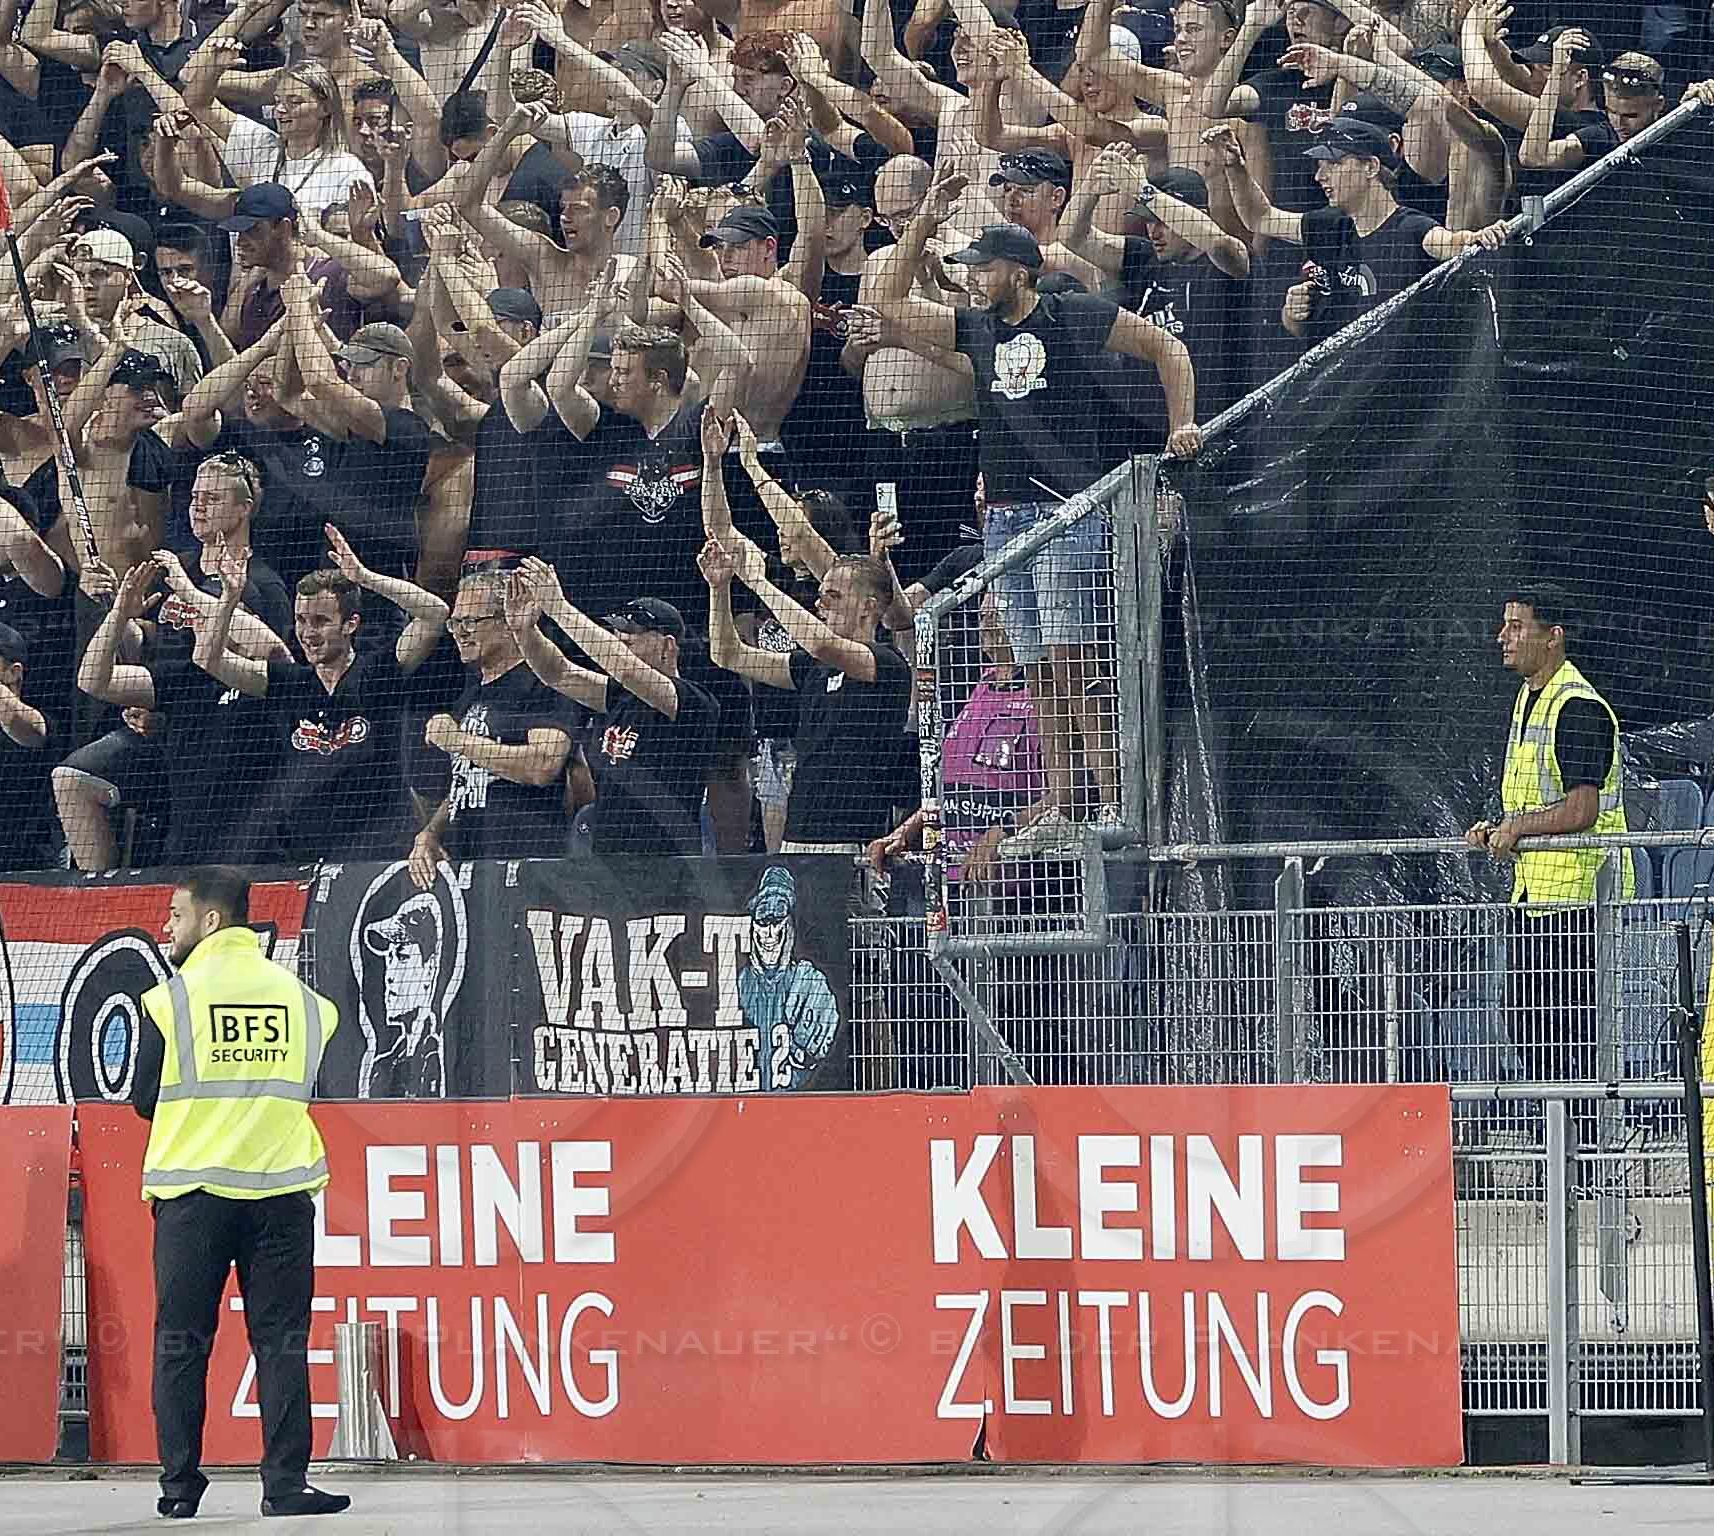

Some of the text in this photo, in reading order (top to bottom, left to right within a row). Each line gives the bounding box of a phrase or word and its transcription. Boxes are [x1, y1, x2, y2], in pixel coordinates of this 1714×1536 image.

[221, 1014, 282, 1044] BFS
[525, 908, 753, 1030] VAK-T
[211, 1048, 288, 1064] SECURITY
[532, 1022, 793, 1095] GENERATIE 2
[312, 1140, 617, 1268] LEINE
[930, 1131, 1347, 1265] KLEINE
[228, 1291, 622, 1421] ZETUNG
[934, 1287, 1351, 1421] ZEITUNG
